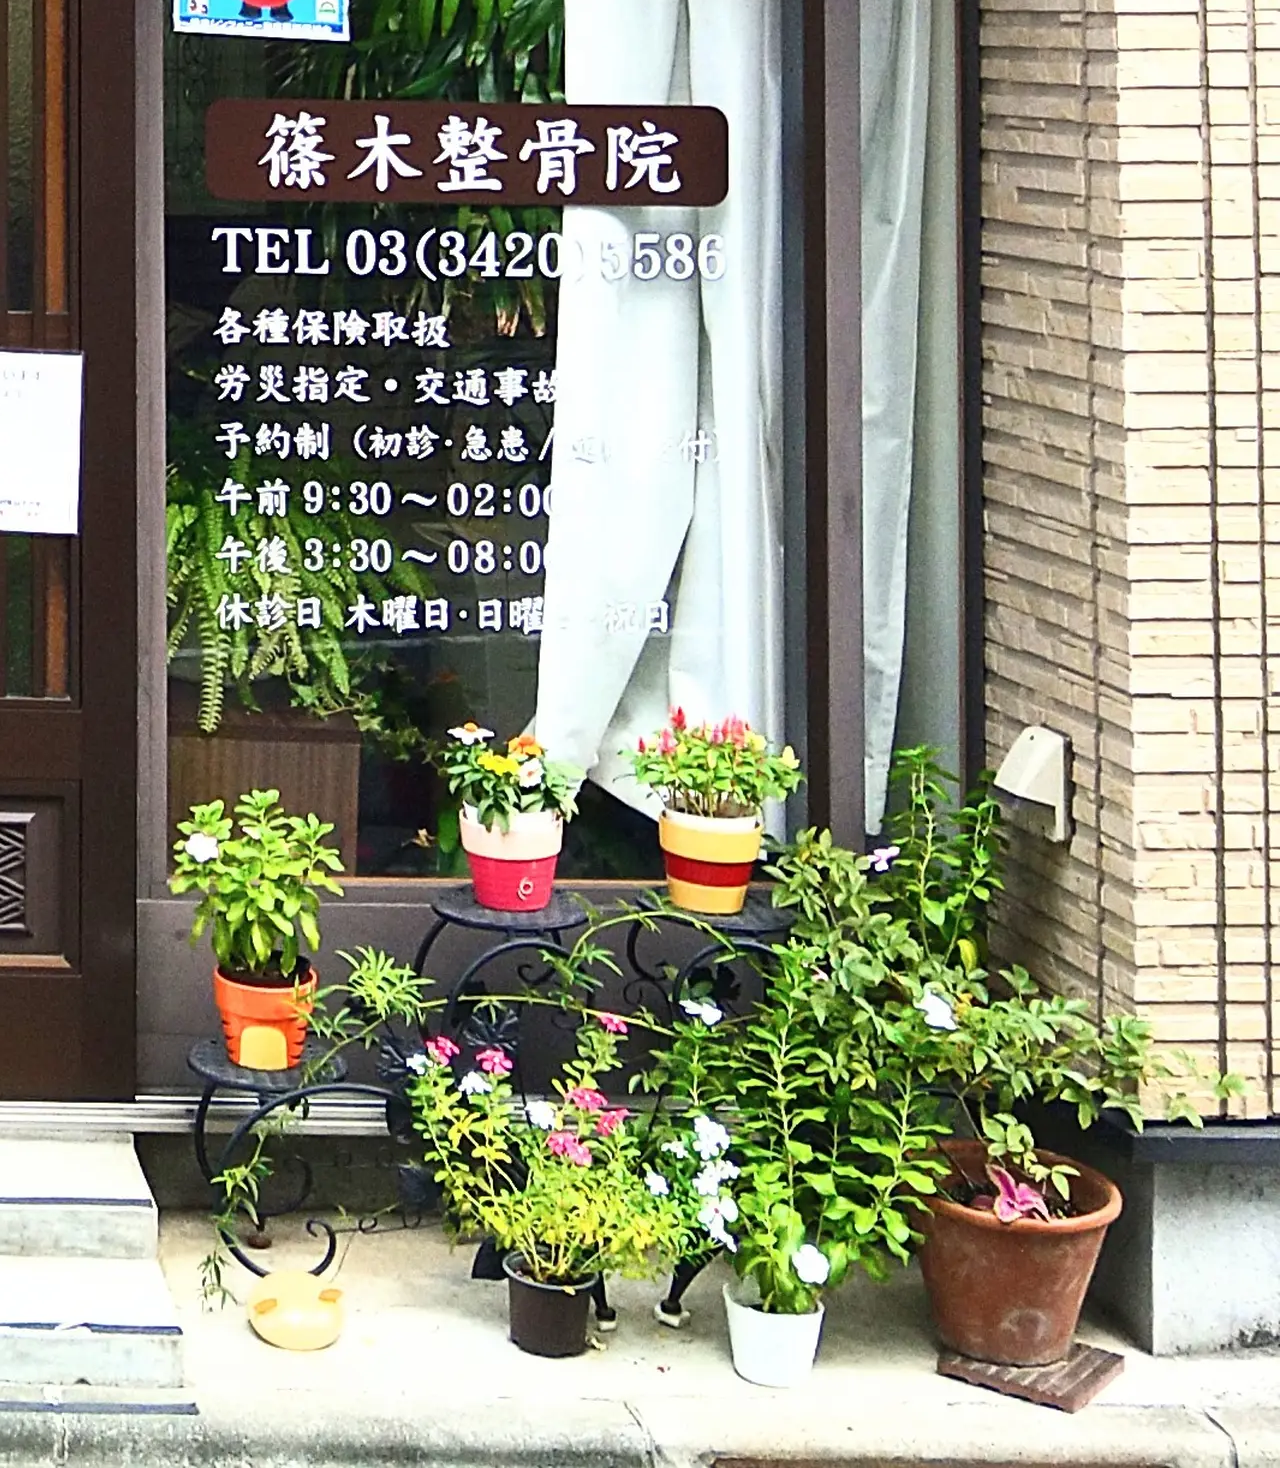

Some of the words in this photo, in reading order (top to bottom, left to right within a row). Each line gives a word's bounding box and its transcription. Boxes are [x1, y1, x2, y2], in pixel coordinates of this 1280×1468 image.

[257, 111, 682, 195] 篠木整骨院
[211, 227, 331, 275] TEL
[213, 306, 452, 349] 各種保険取扱
[304, 537, 547, 576] 3:30～08:0
[214, 594, 324, 632] 休診日
